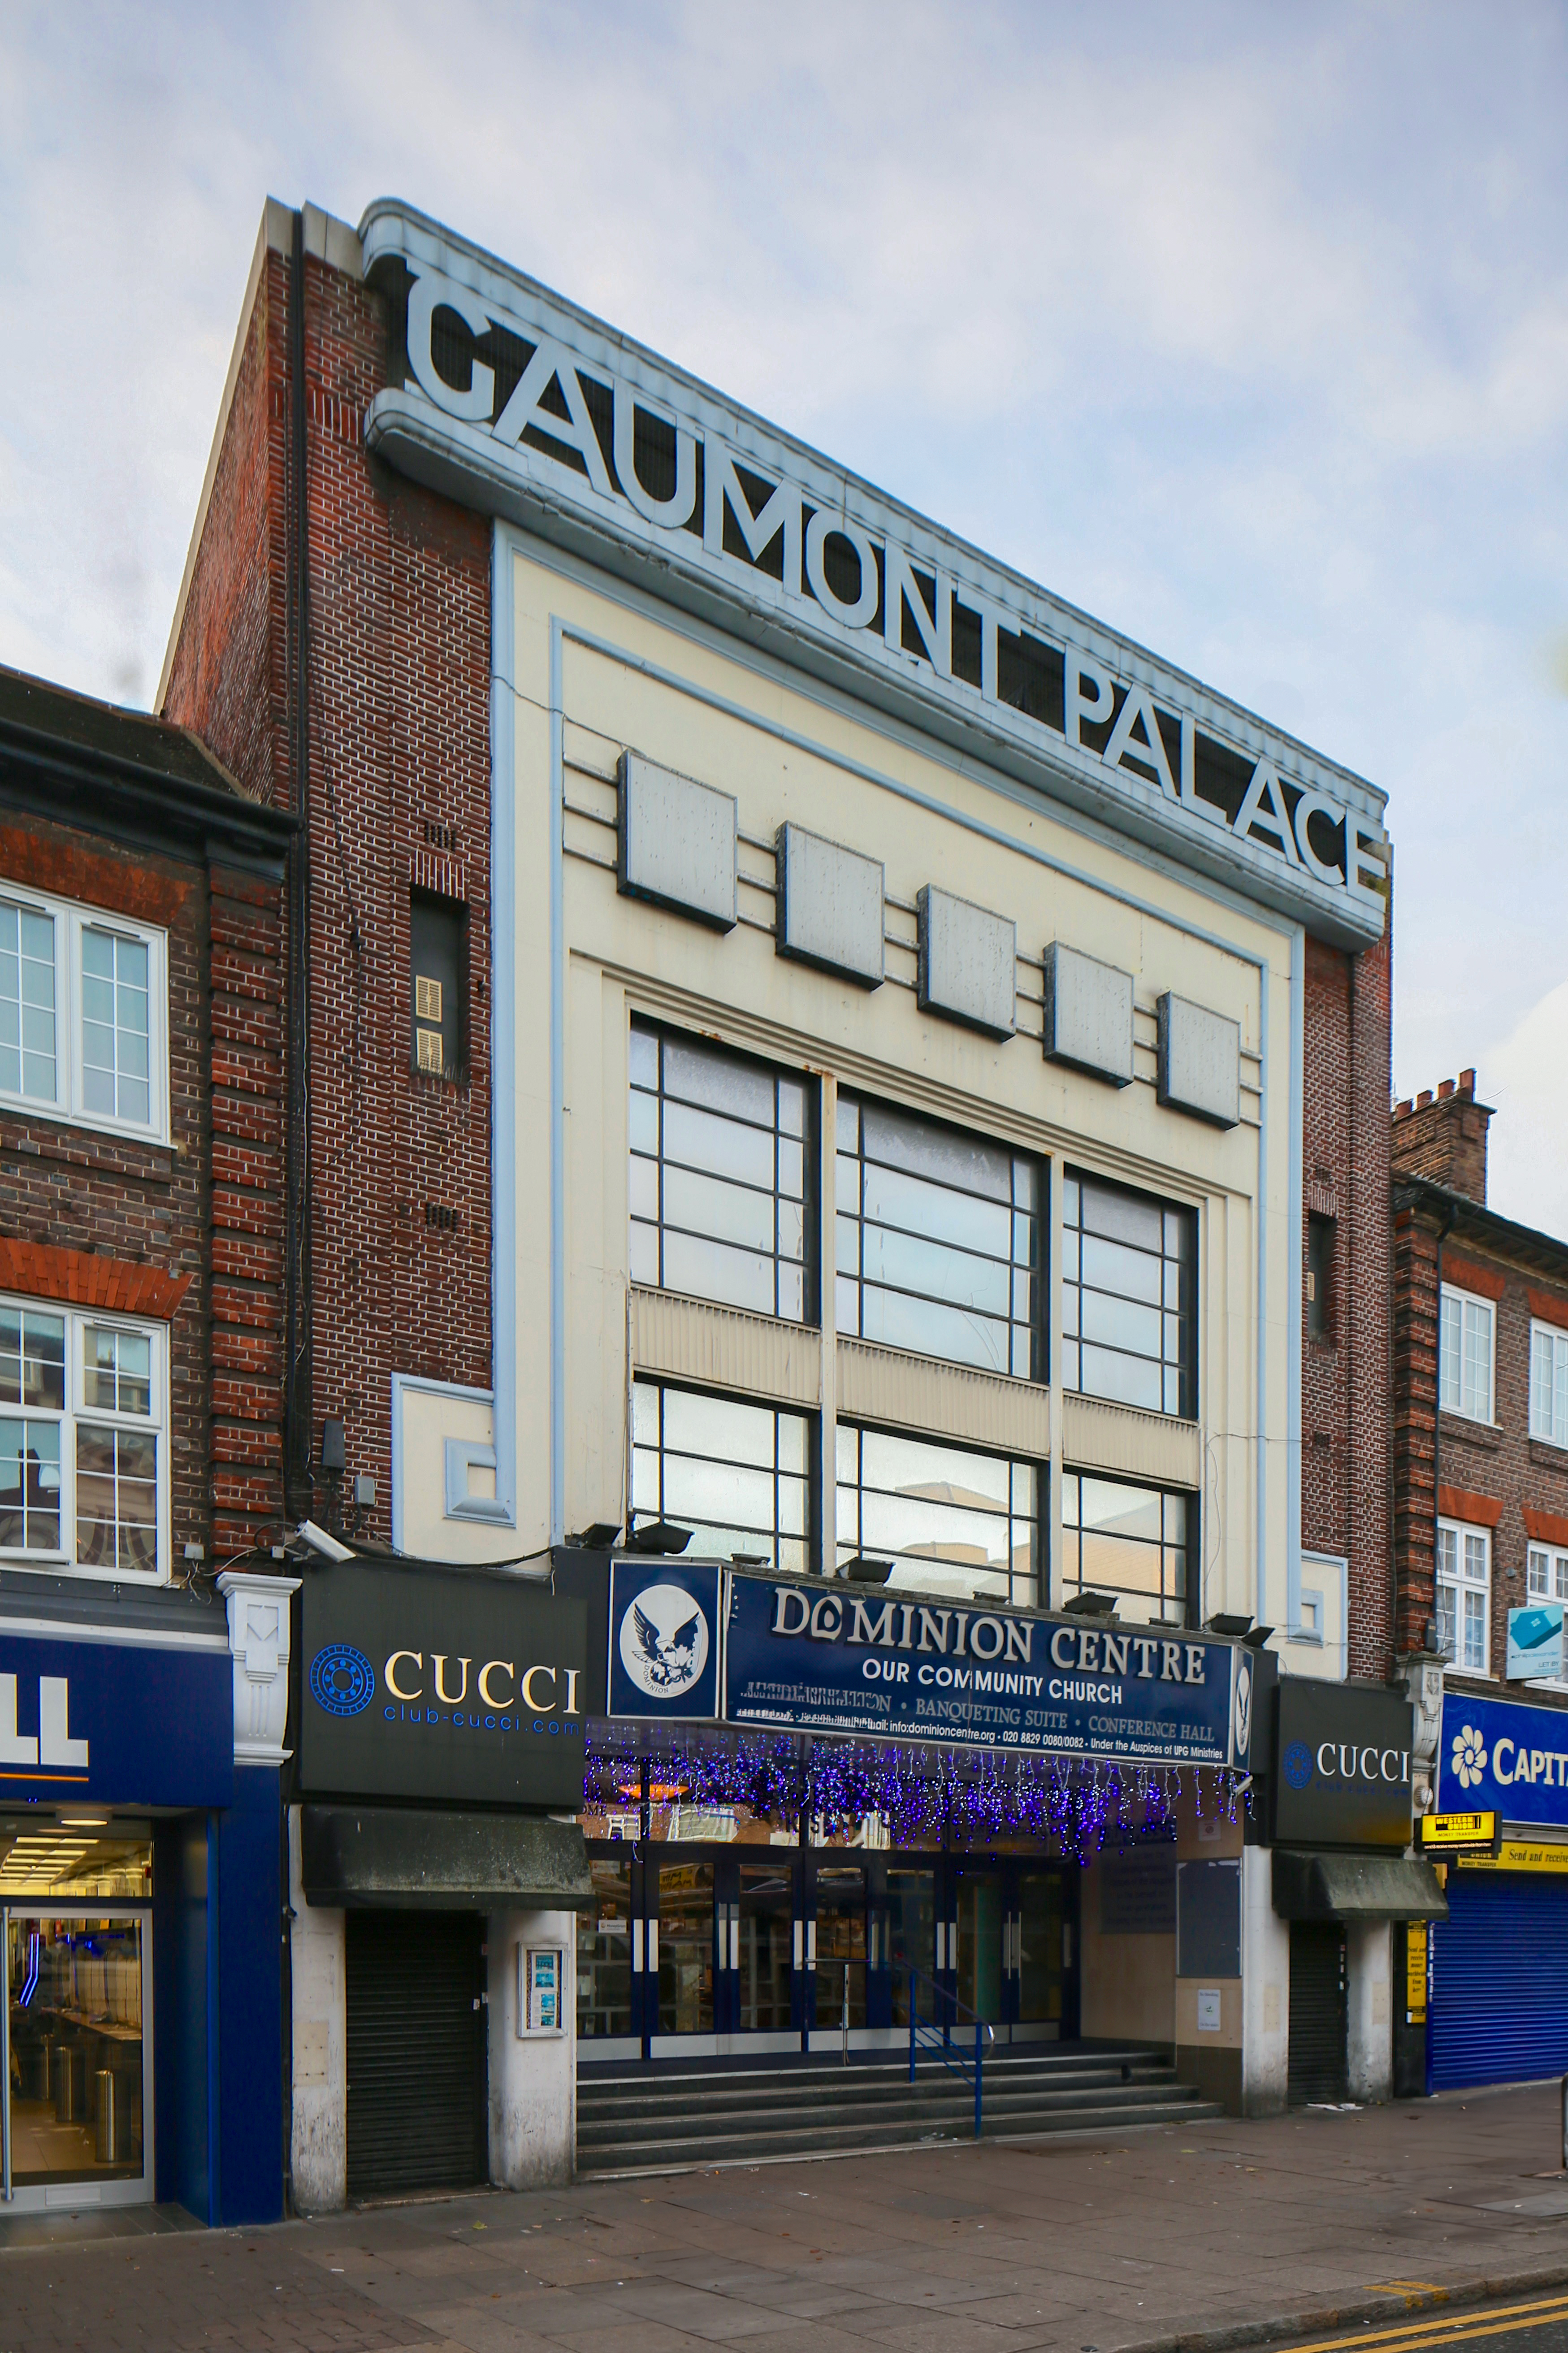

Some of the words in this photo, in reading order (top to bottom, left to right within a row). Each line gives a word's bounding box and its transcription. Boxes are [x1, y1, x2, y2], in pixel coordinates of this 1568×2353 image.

[407, 268, 1021, 702] GAUMONT
[1064, 643, 1387, 913] PALACE
[772, 1587, 1034, 1663] DOMINION
[1051, 1628, 1205, 1684] CENTRE
[384, 1651, 581, 1714] CUCCI
[643, 1664, 669, 1693] DOMINION
[862, 1658, 910, 1682] OUR
[918, 1664, 1043, 1696] COMMUNITY
[1049, 1679, 1122, 1704] CHURCH
[384, 1704, 579, 1735] club-cucci.com
[916, 1698, 1021, 1725] BANQUETING
[1025, 1709, 1068, 1729] SUITE
[1089, 1716, 1176, 1738] CONFERENCE
[1181, 1725, 1215, 1742] HALL
[1003, 1731, 1018, 1742] 020
[1021, 1732, 1040, 1744] 8829
[1043, 1734, 1083, 1748] 0080/0082
[1091, 1738, 1113, 1750] Under
[1116, 1740, 1128, 1751] the
[1130, 1741, 1162, 1755] Auspices
[1165, 1746, 1172, 1755] of
[1174, 1746, 1189, 1756] UPG
[1191, 1746, 1223, 1759] Ministries
[1317, 1742, 1410, 1782] CUCCI
[1493, 1738, 1568, 1787] CAPIT
[1436, 1816, 1473, 1824] WESTERN
[1509, 1849, 1527, 1861] Send
[1530, 1850, 1543, 1862] and
